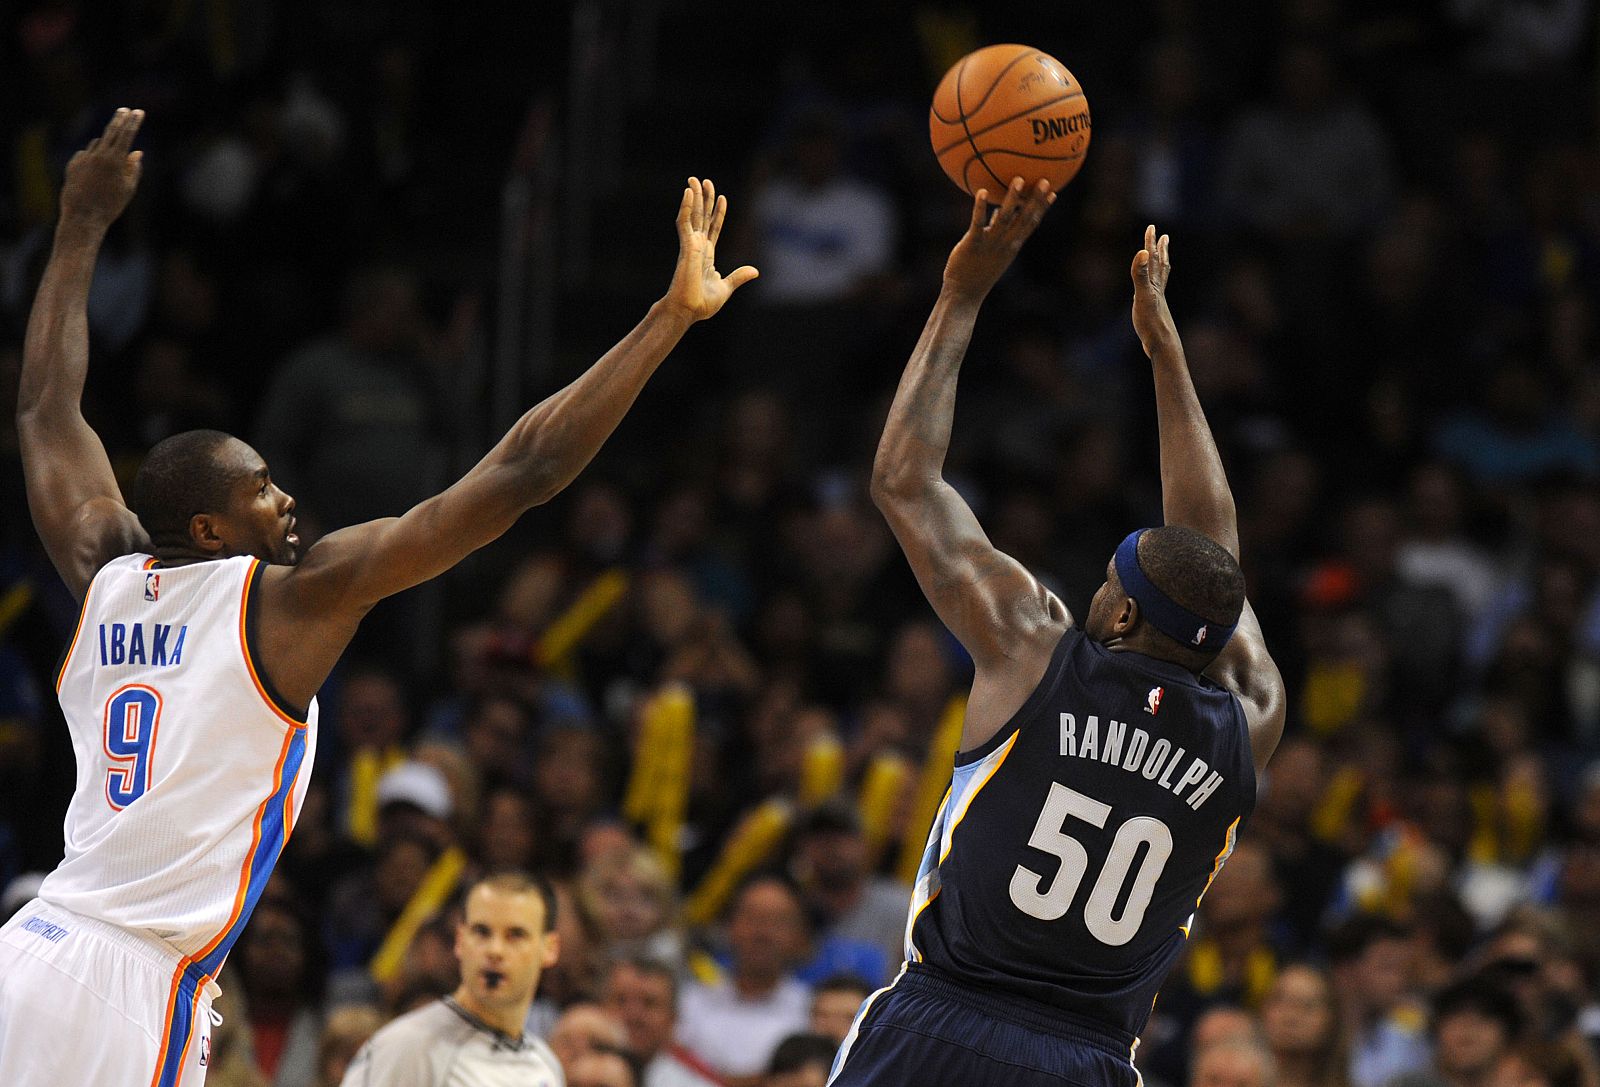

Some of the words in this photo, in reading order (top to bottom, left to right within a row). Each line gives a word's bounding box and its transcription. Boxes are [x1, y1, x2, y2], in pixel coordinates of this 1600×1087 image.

[99, 623, 188, 667] IBAKA
[103, 683, 163, 812] 9
[1060, 712, 1224, 811] RANDOLPH
[1009, 781, 1173, 946] 50
